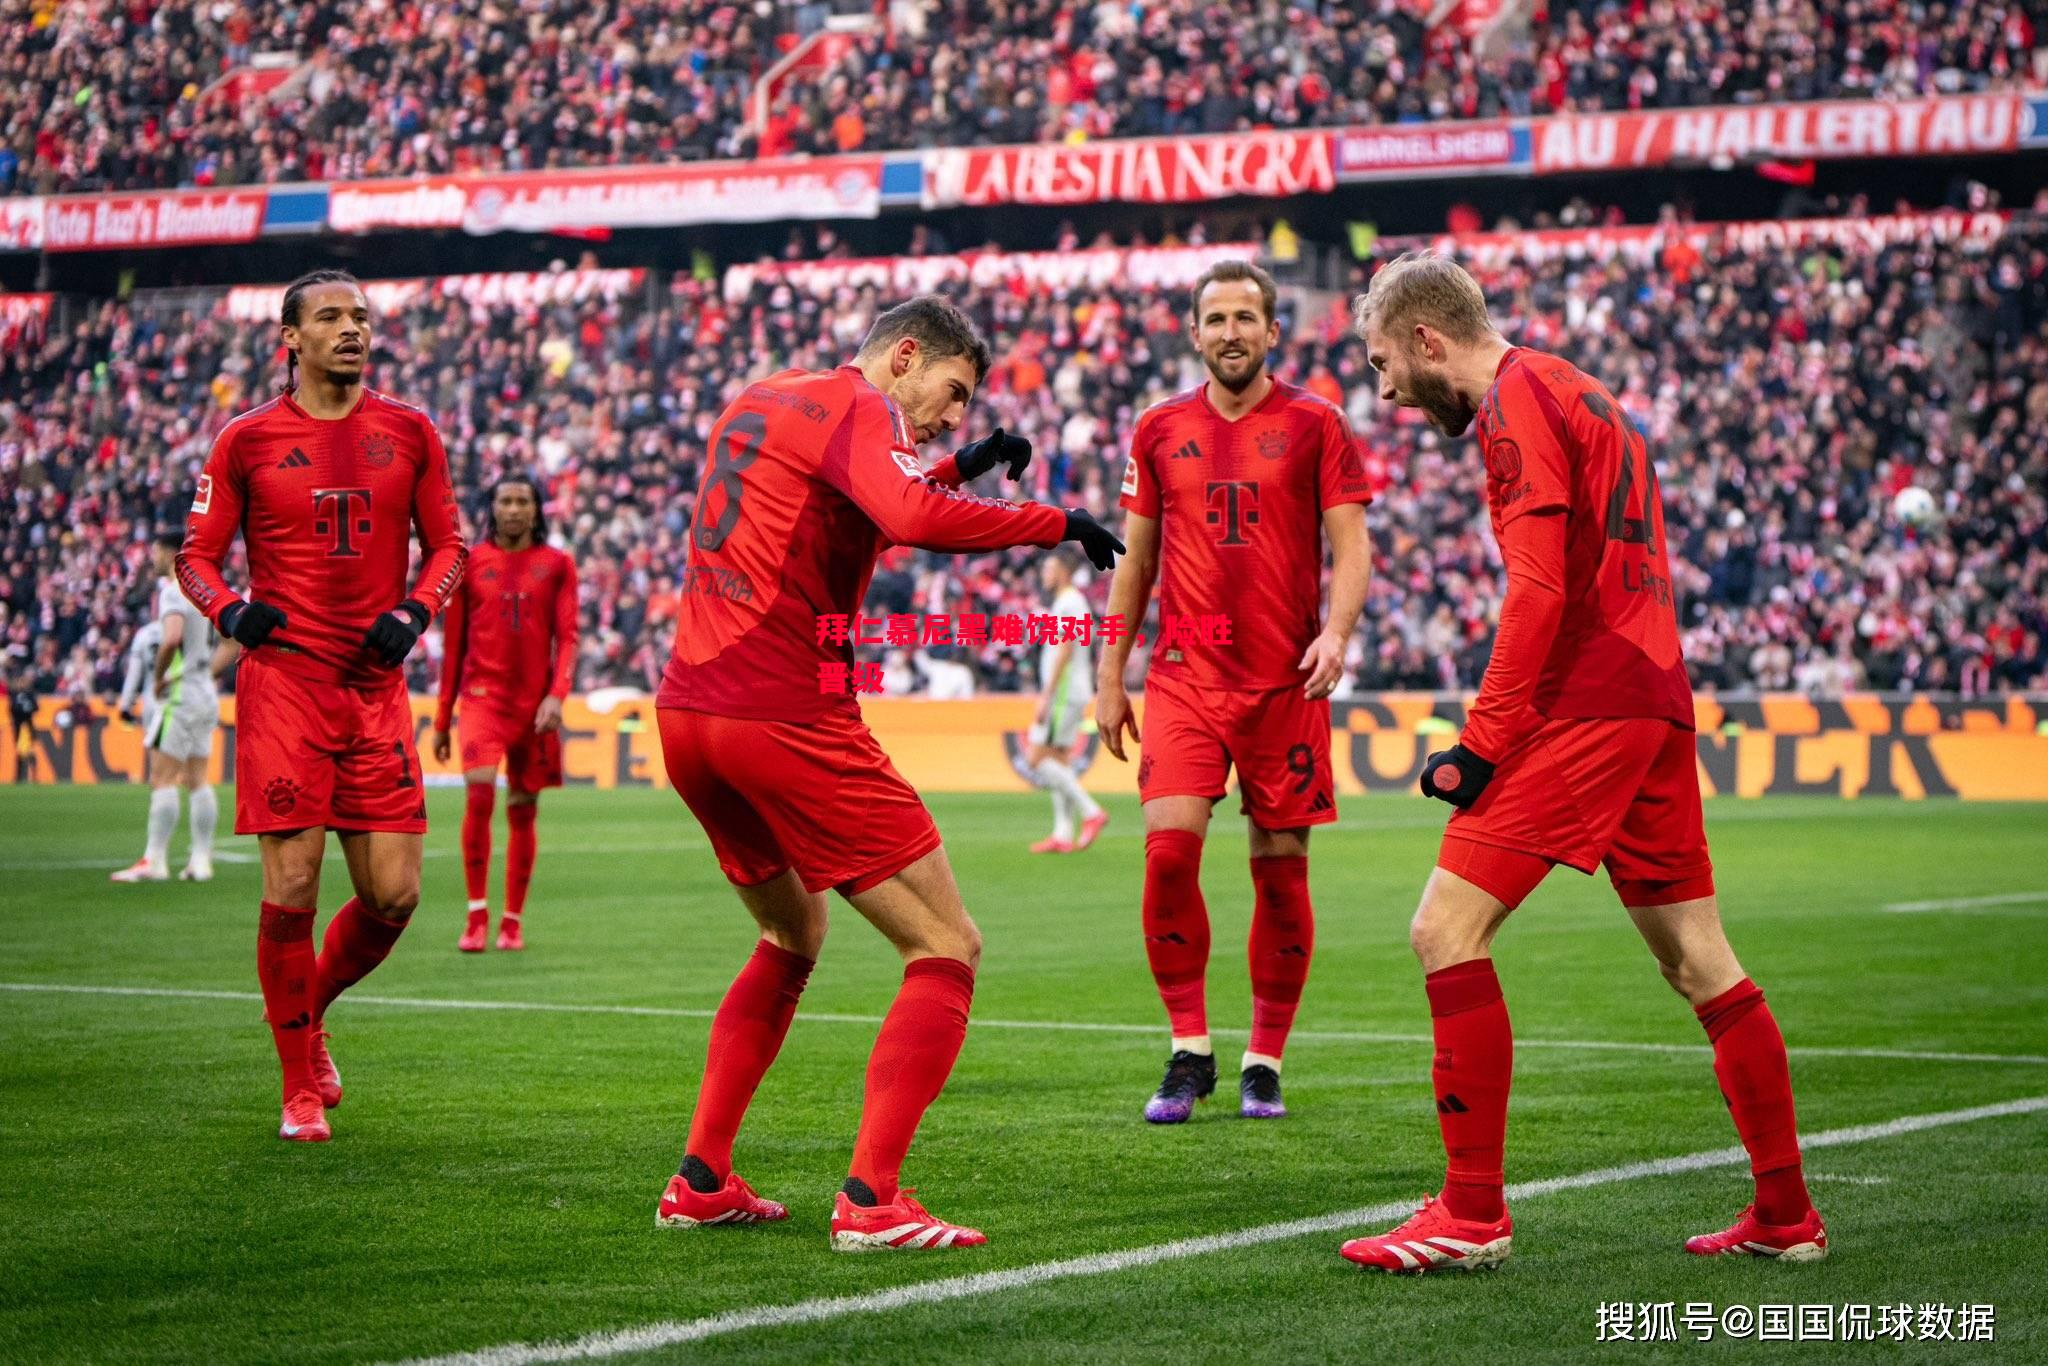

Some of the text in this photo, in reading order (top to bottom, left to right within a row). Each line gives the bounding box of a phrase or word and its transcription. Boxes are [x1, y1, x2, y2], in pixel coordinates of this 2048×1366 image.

[1013, 141, 1168, 203] BESTIA
[1173, 131, 1336, 199] NEGRA
[1540, 119, 1619, 167] AU
[1669, 100, 2014, 156] HALLERTAU
[693, 411, 766, 552] 8
[1206, 481, 1259, 546] T
[311, 488, 371, 557] T
[1287, 743, 1315, 795] 9
